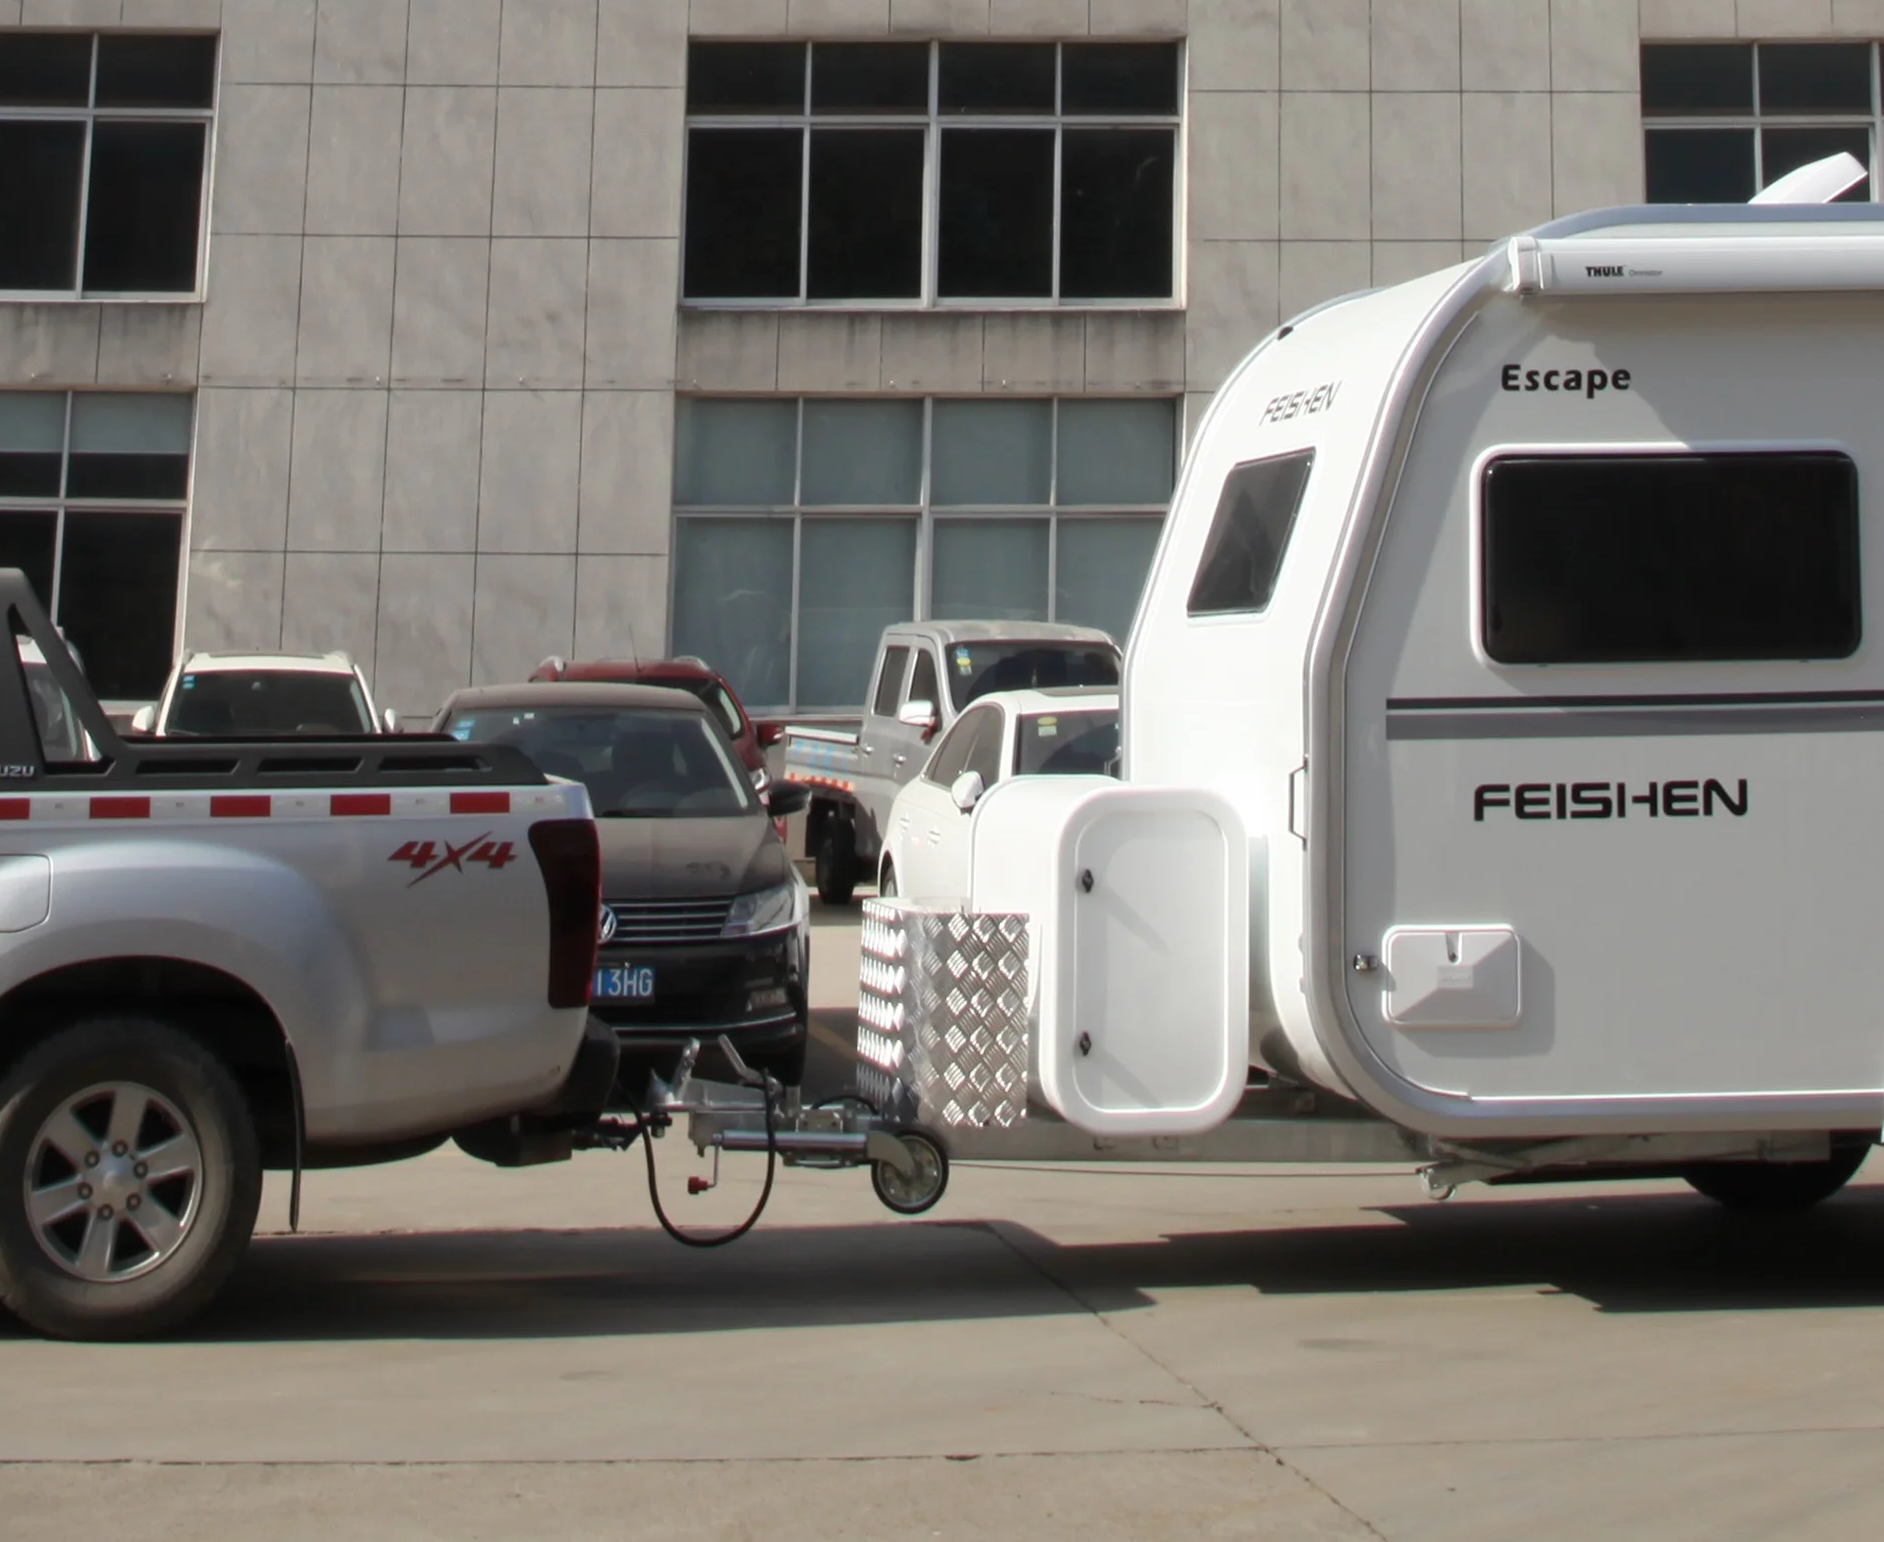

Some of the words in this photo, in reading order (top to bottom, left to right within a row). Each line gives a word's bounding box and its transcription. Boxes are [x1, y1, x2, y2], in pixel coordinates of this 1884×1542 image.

[1585, 265, 1624, 278] THULE
[1501, 364, 1632, 399] Escape
[1259, 381, 1343, 427] FEISHEN
[1473, 778, 1749, 822] FEISHEN
